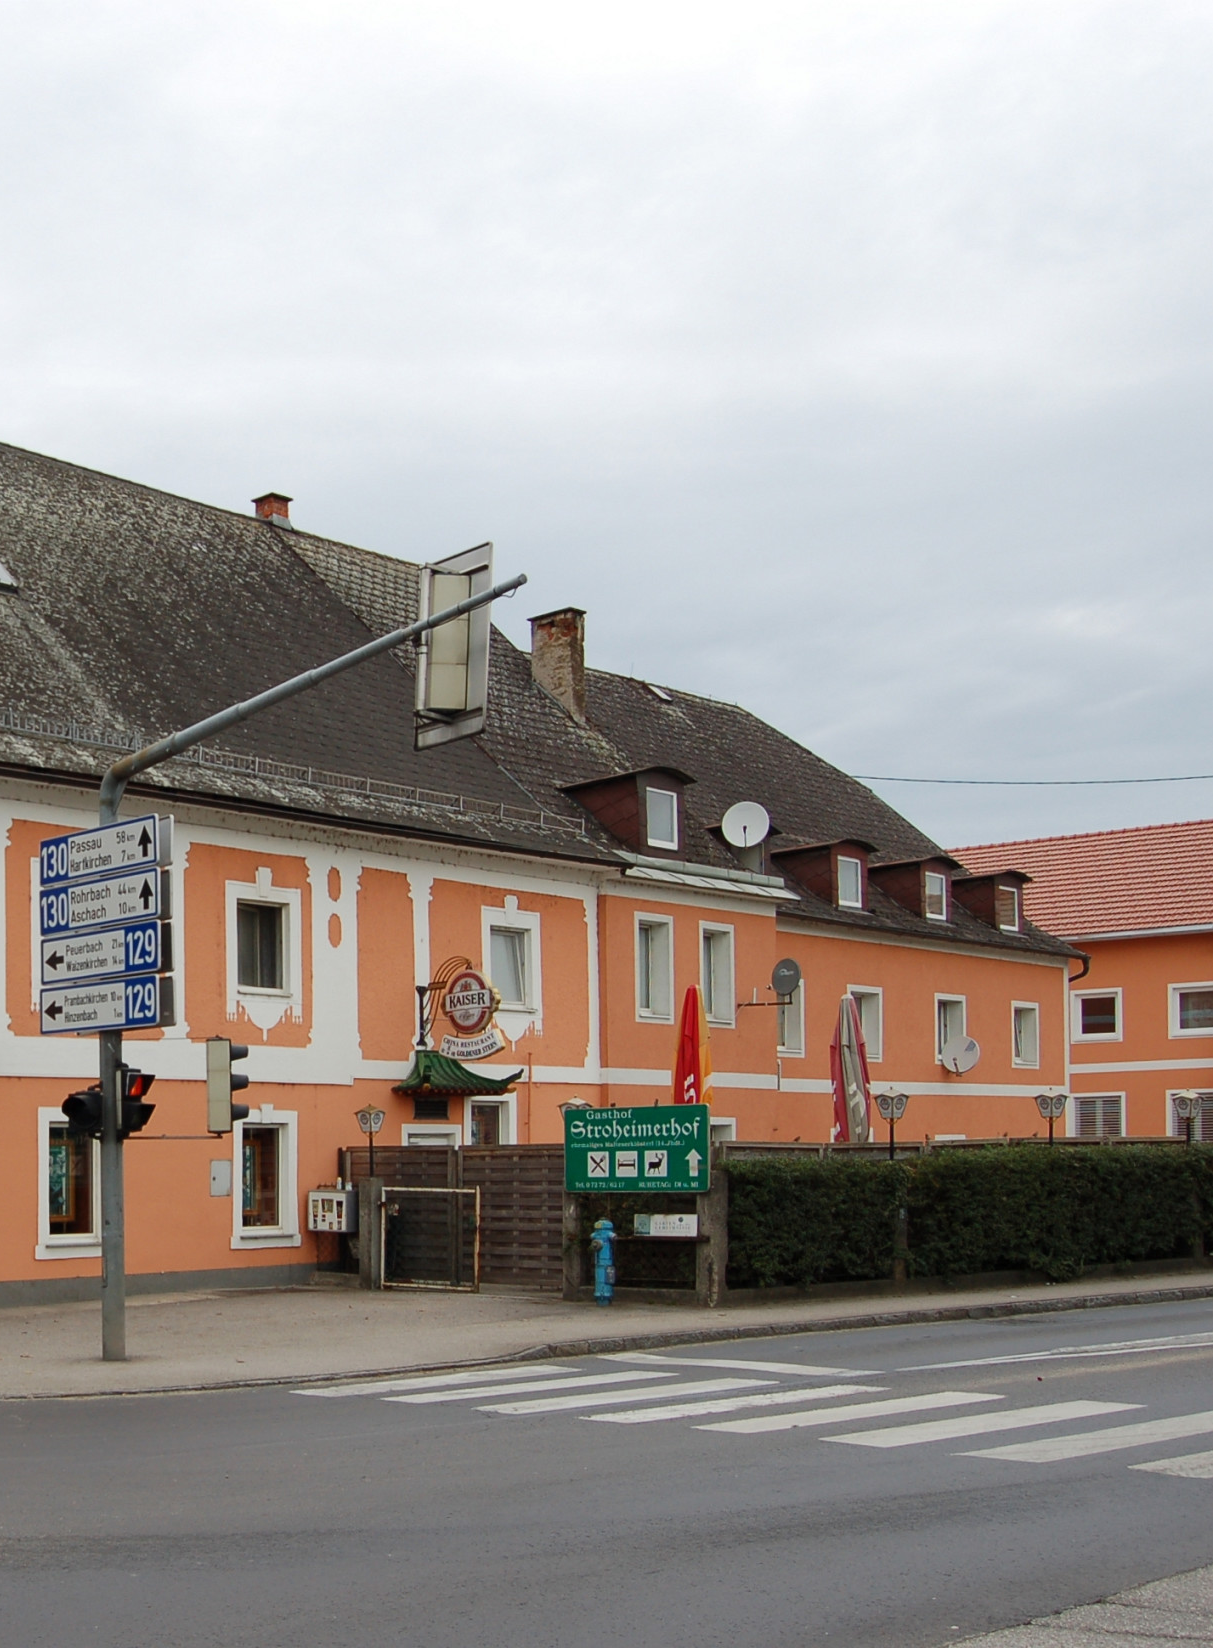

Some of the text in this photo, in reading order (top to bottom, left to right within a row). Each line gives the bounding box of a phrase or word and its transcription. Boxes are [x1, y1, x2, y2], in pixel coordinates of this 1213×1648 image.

[70, 837, 102, 854] Passau
[116, 831, 126, 844] 58
[41, 843, 67, 878] 130
[70, 853, 112, 873] Hartkirchen
[122, 850, 126, 862] 7
[71, 886, 111, 904] Rohrbach
[118, 883, 127, 895] 44
[41, 893, 67, 928] 130
[71, 905, 106, 923] Aschach
[119, 902, 127, 914] 10
[66, 940, 103, 956] Peuerbach
[126, 929, 155, 966] 129
[66, 956, 108, 972] Waizenkirchen
[64, 991, 108, 1006] Prambachkirchen
[126, 985, 155, 1020] 129
[449, 992, 486, 1009] KAISER
[64, 1009, 98, 1023] Hinzenbach
[586, 1109, 632, 1120] Gasthof
[571, 1117, 700, 1141] Stroheimerhof
